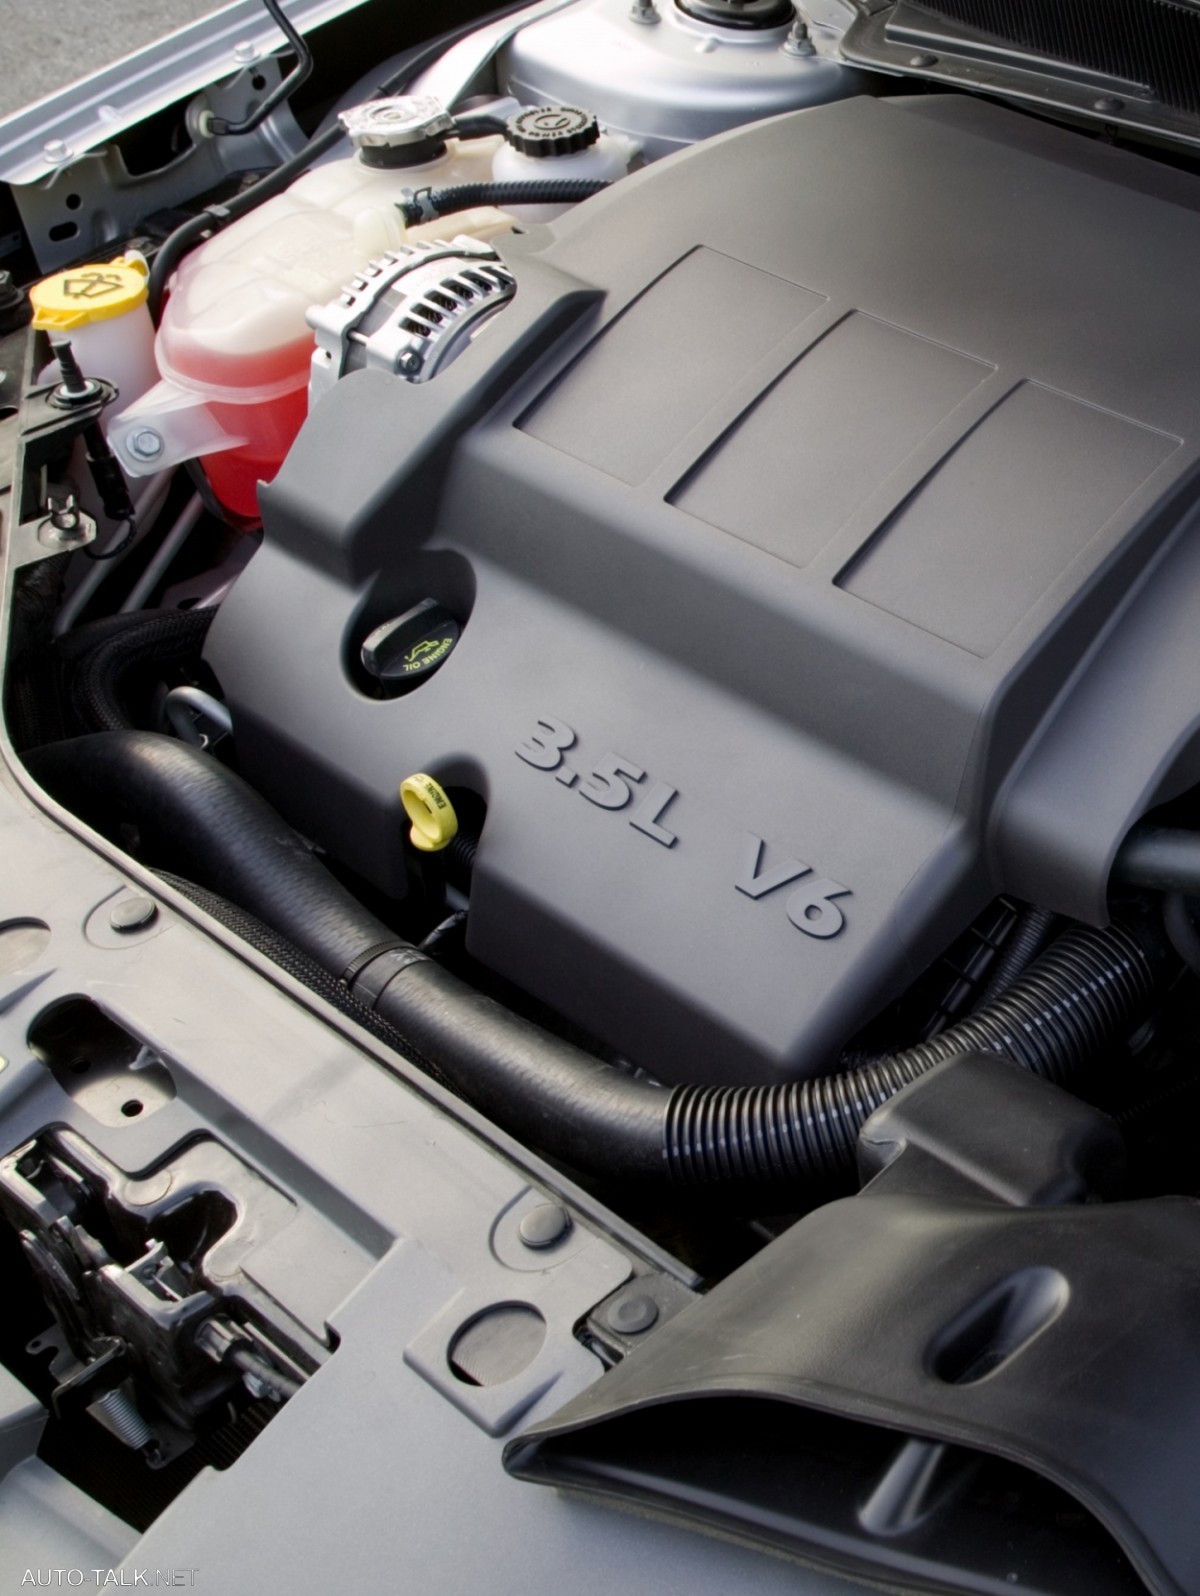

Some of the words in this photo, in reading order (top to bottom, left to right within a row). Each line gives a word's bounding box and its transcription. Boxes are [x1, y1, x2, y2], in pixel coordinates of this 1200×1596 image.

[421, 638, 453, 665] ENGINE
[403, 661, 421, 671] OIL
[514, 717, 680, 849] 3.5L
[734, 831, 854, 941] V6
